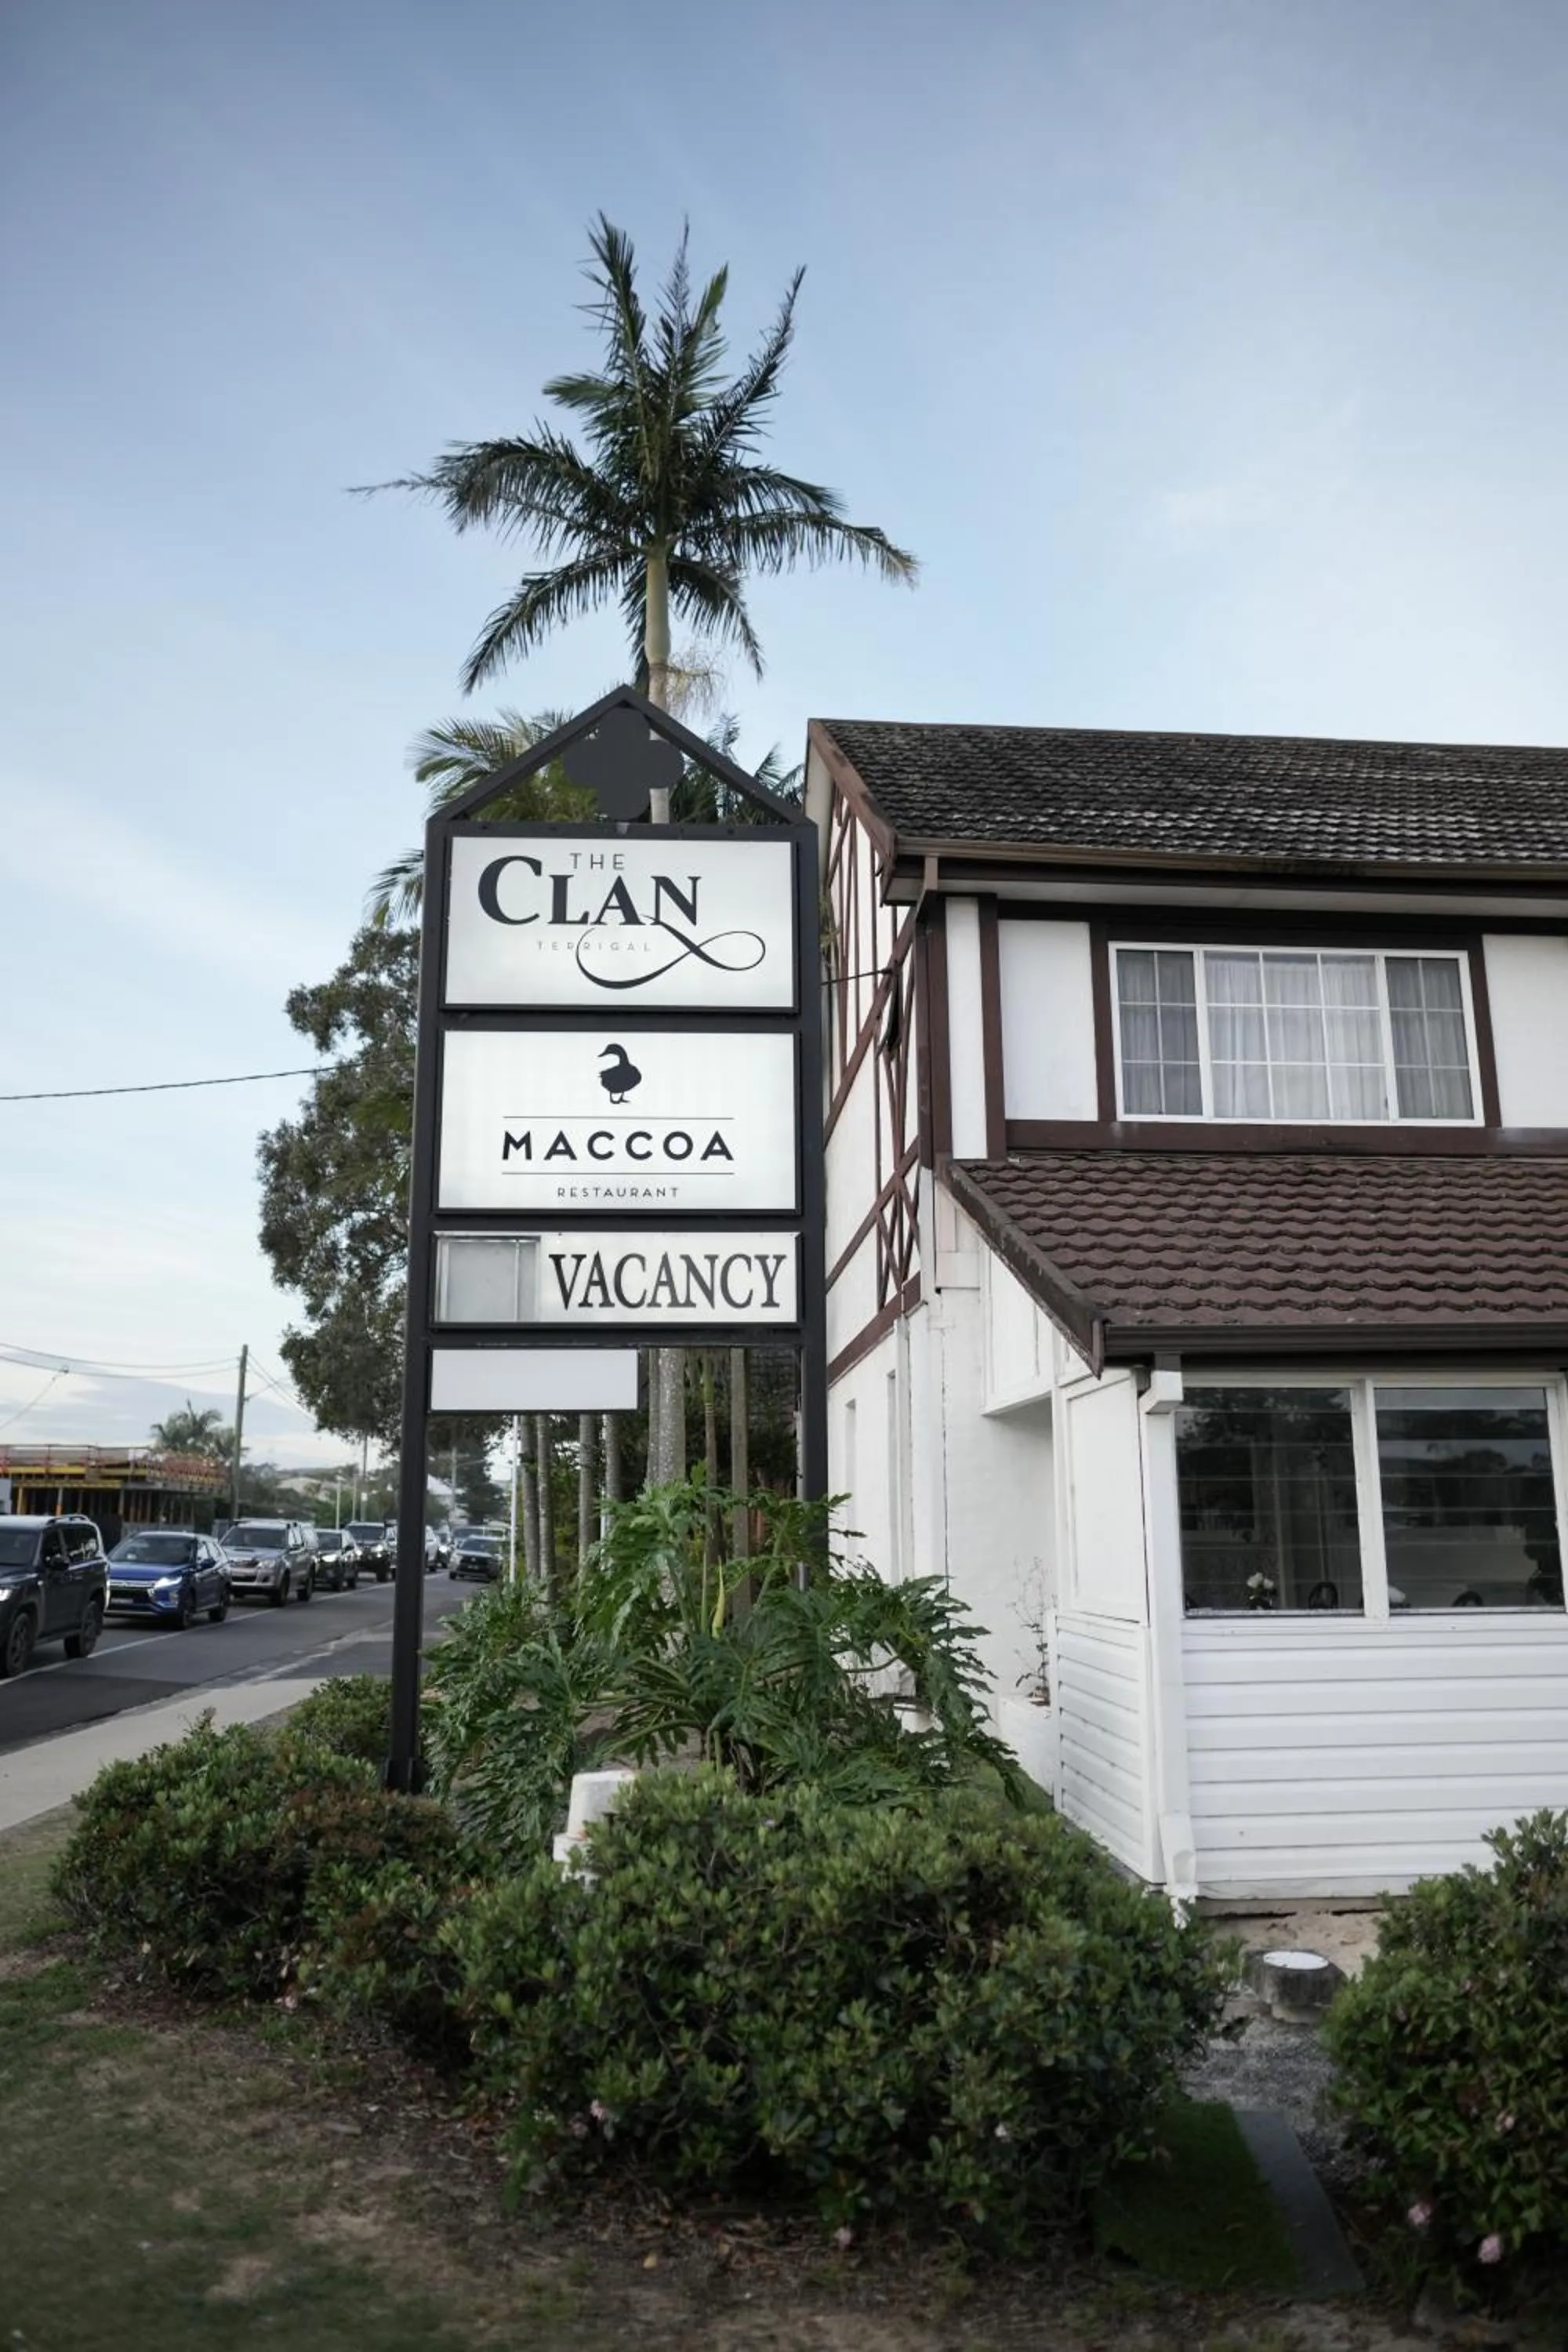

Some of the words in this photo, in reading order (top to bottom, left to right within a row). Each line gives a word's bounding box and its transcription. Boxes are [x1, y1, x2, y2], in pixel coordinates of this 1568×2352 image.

[570, 852, 626, 869] THE
[537, 942, 651, 952] TERRIGAL
[502, 1131, 735, 1161] MACCOA
[557, 1187, 680, 1198] RESTAURANT
[548, 1251, 787, 1310] VACANCY
